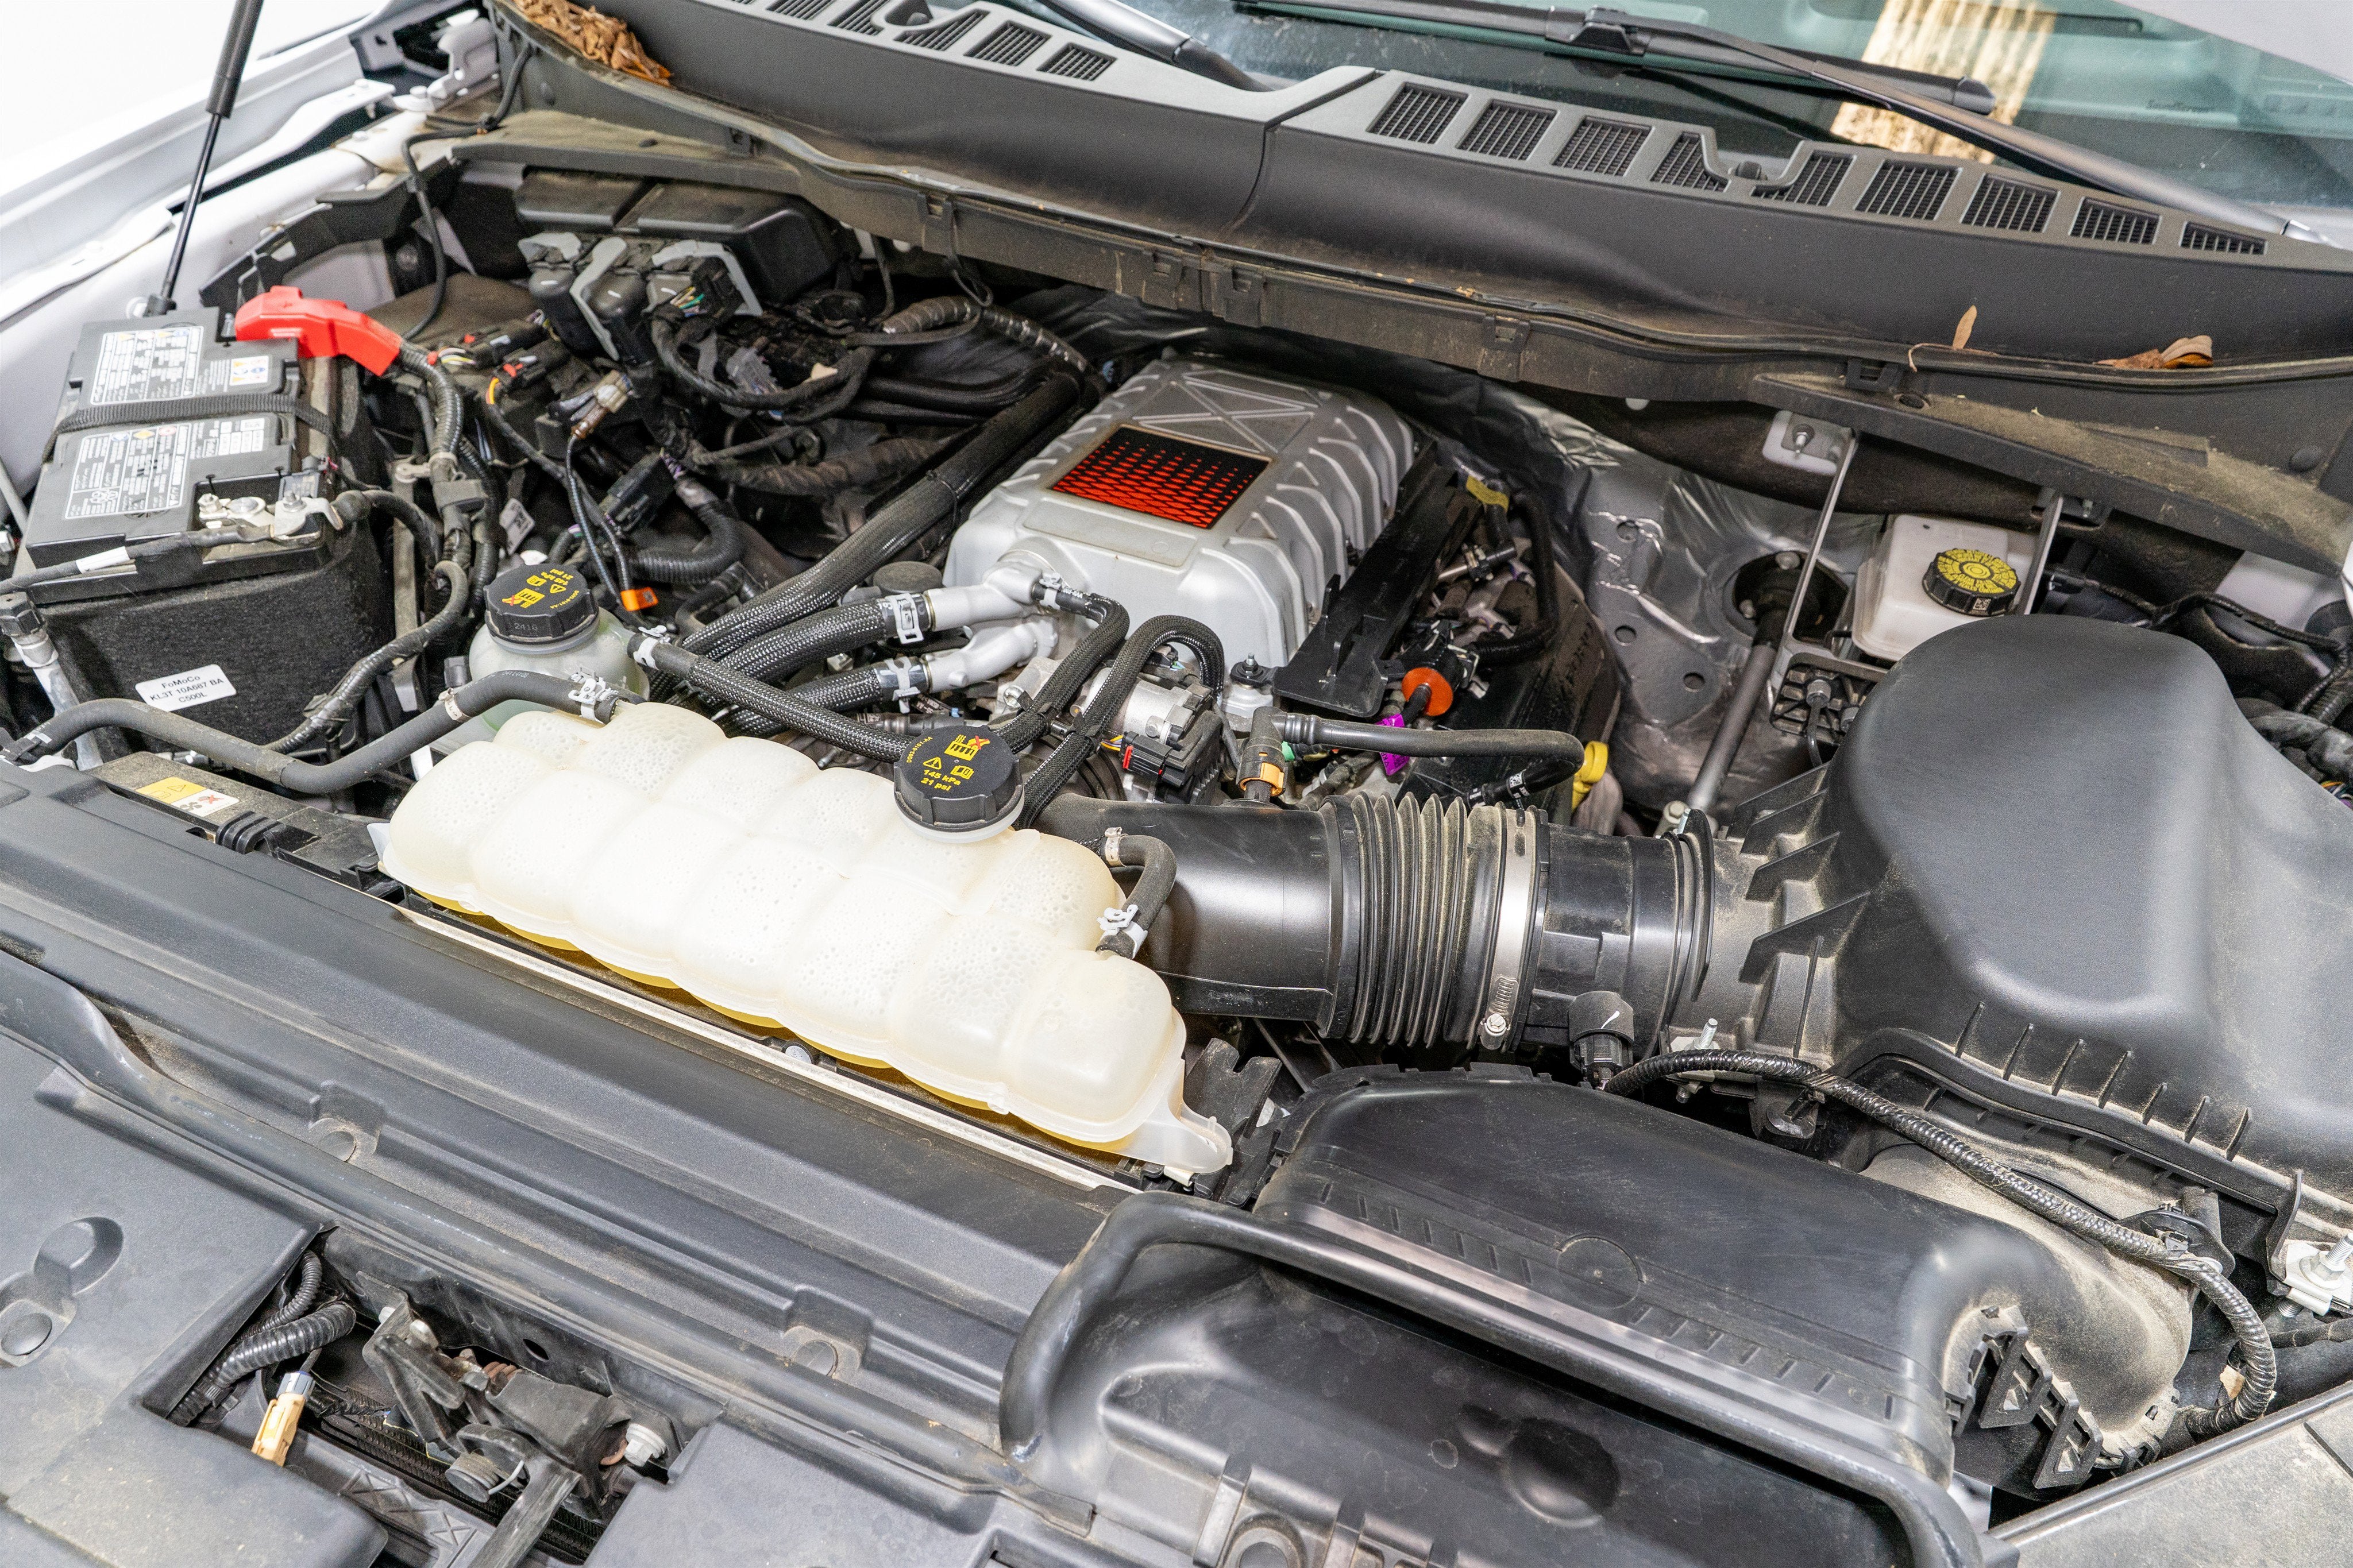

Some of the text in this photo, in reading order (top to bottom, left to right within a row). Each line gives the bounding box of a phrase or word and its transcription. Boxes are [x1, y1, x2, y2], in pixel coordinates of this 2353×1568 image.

[541, 571, 569, 585] 145 kPa
[161, 675, 200, 689] FoMoCo
[150, 678, 224, 701] KL3T 10A687 BA
[179, 692, 207, 703] C500L
[924, 770, 961, 785] 145 kPa
[934, 783, 951, 791] psi
